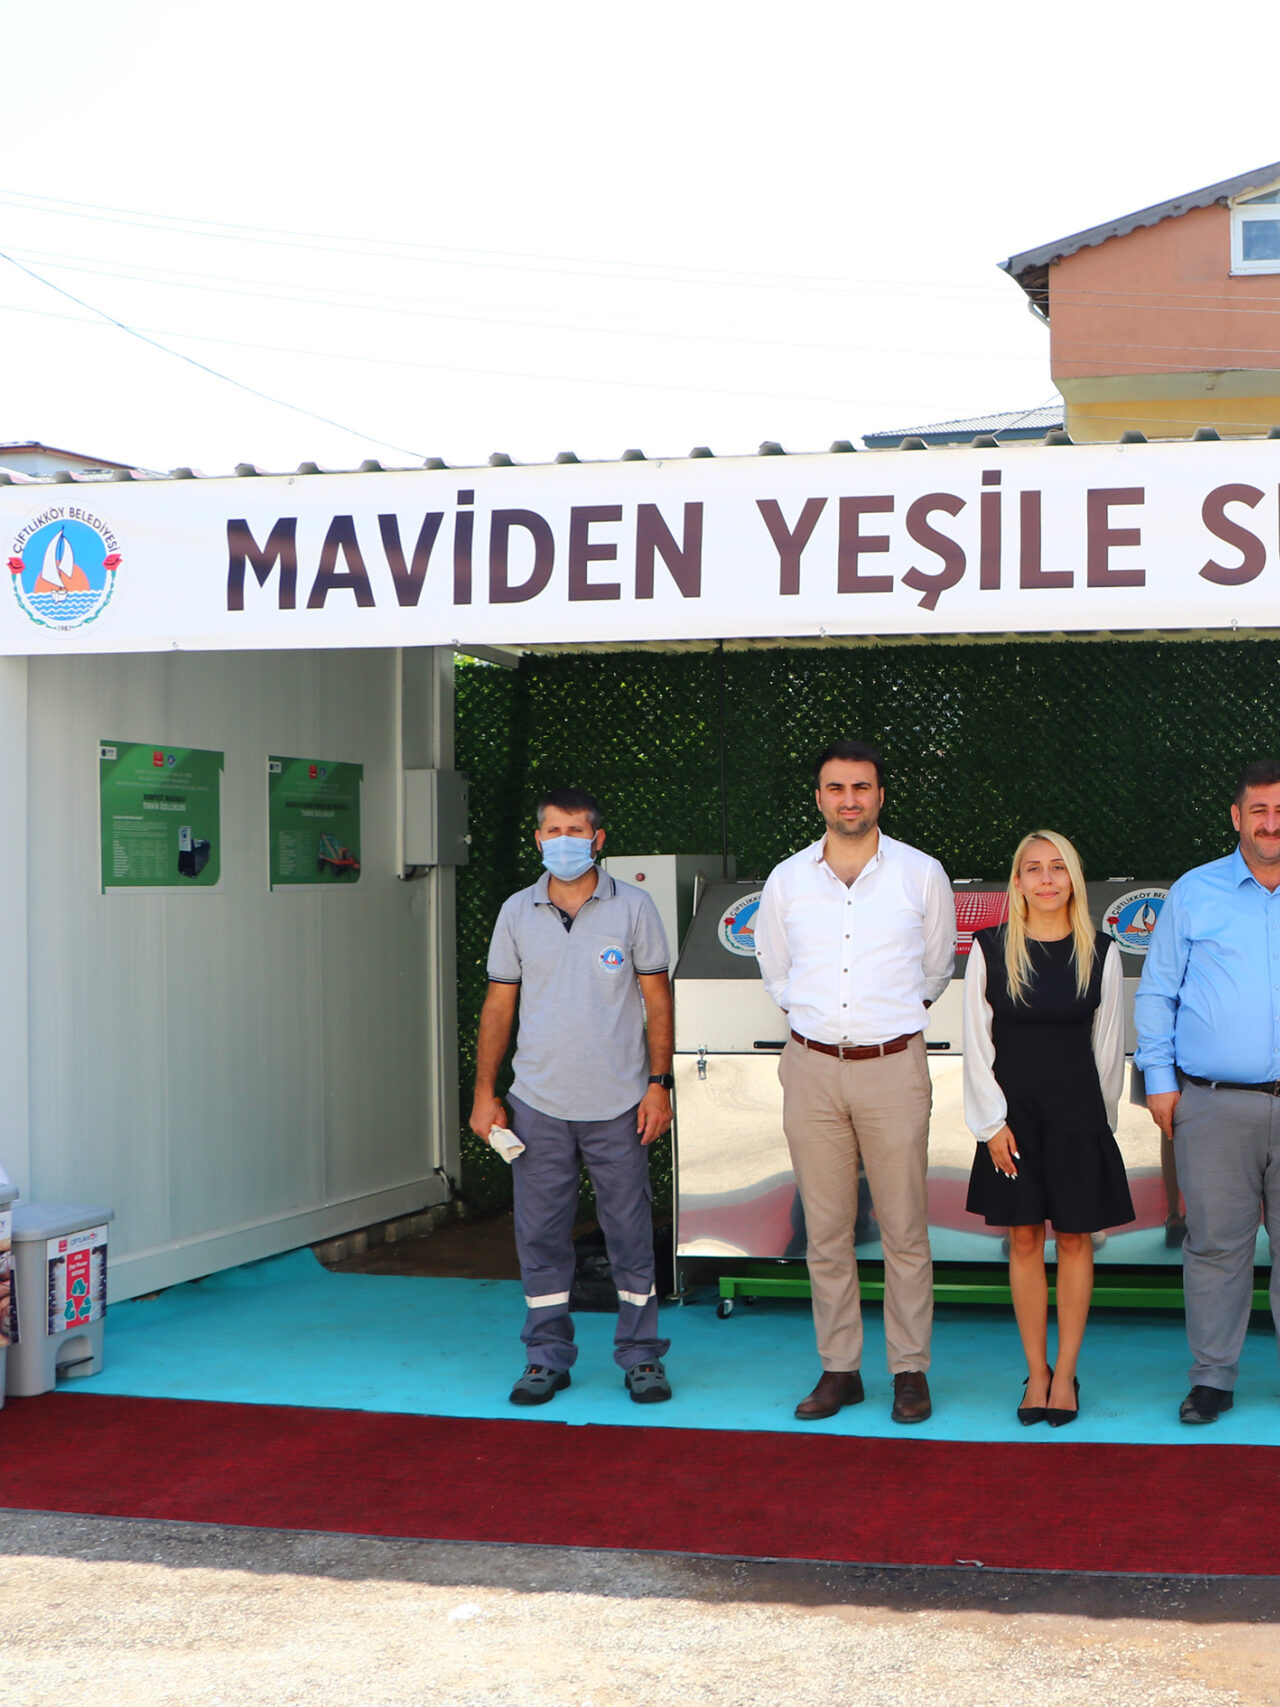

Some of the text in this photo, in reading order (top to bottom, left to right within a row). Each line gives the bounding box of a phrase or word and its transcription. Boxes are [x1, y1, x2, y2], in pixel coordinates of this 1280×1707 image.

[12, 506, 121, 555] ÇİFTLİKKÖY BELEDİYESİ
[227, 489, 704, 611] MAVİDEN
[755, 469, 1146, 612] YEŞİLE
